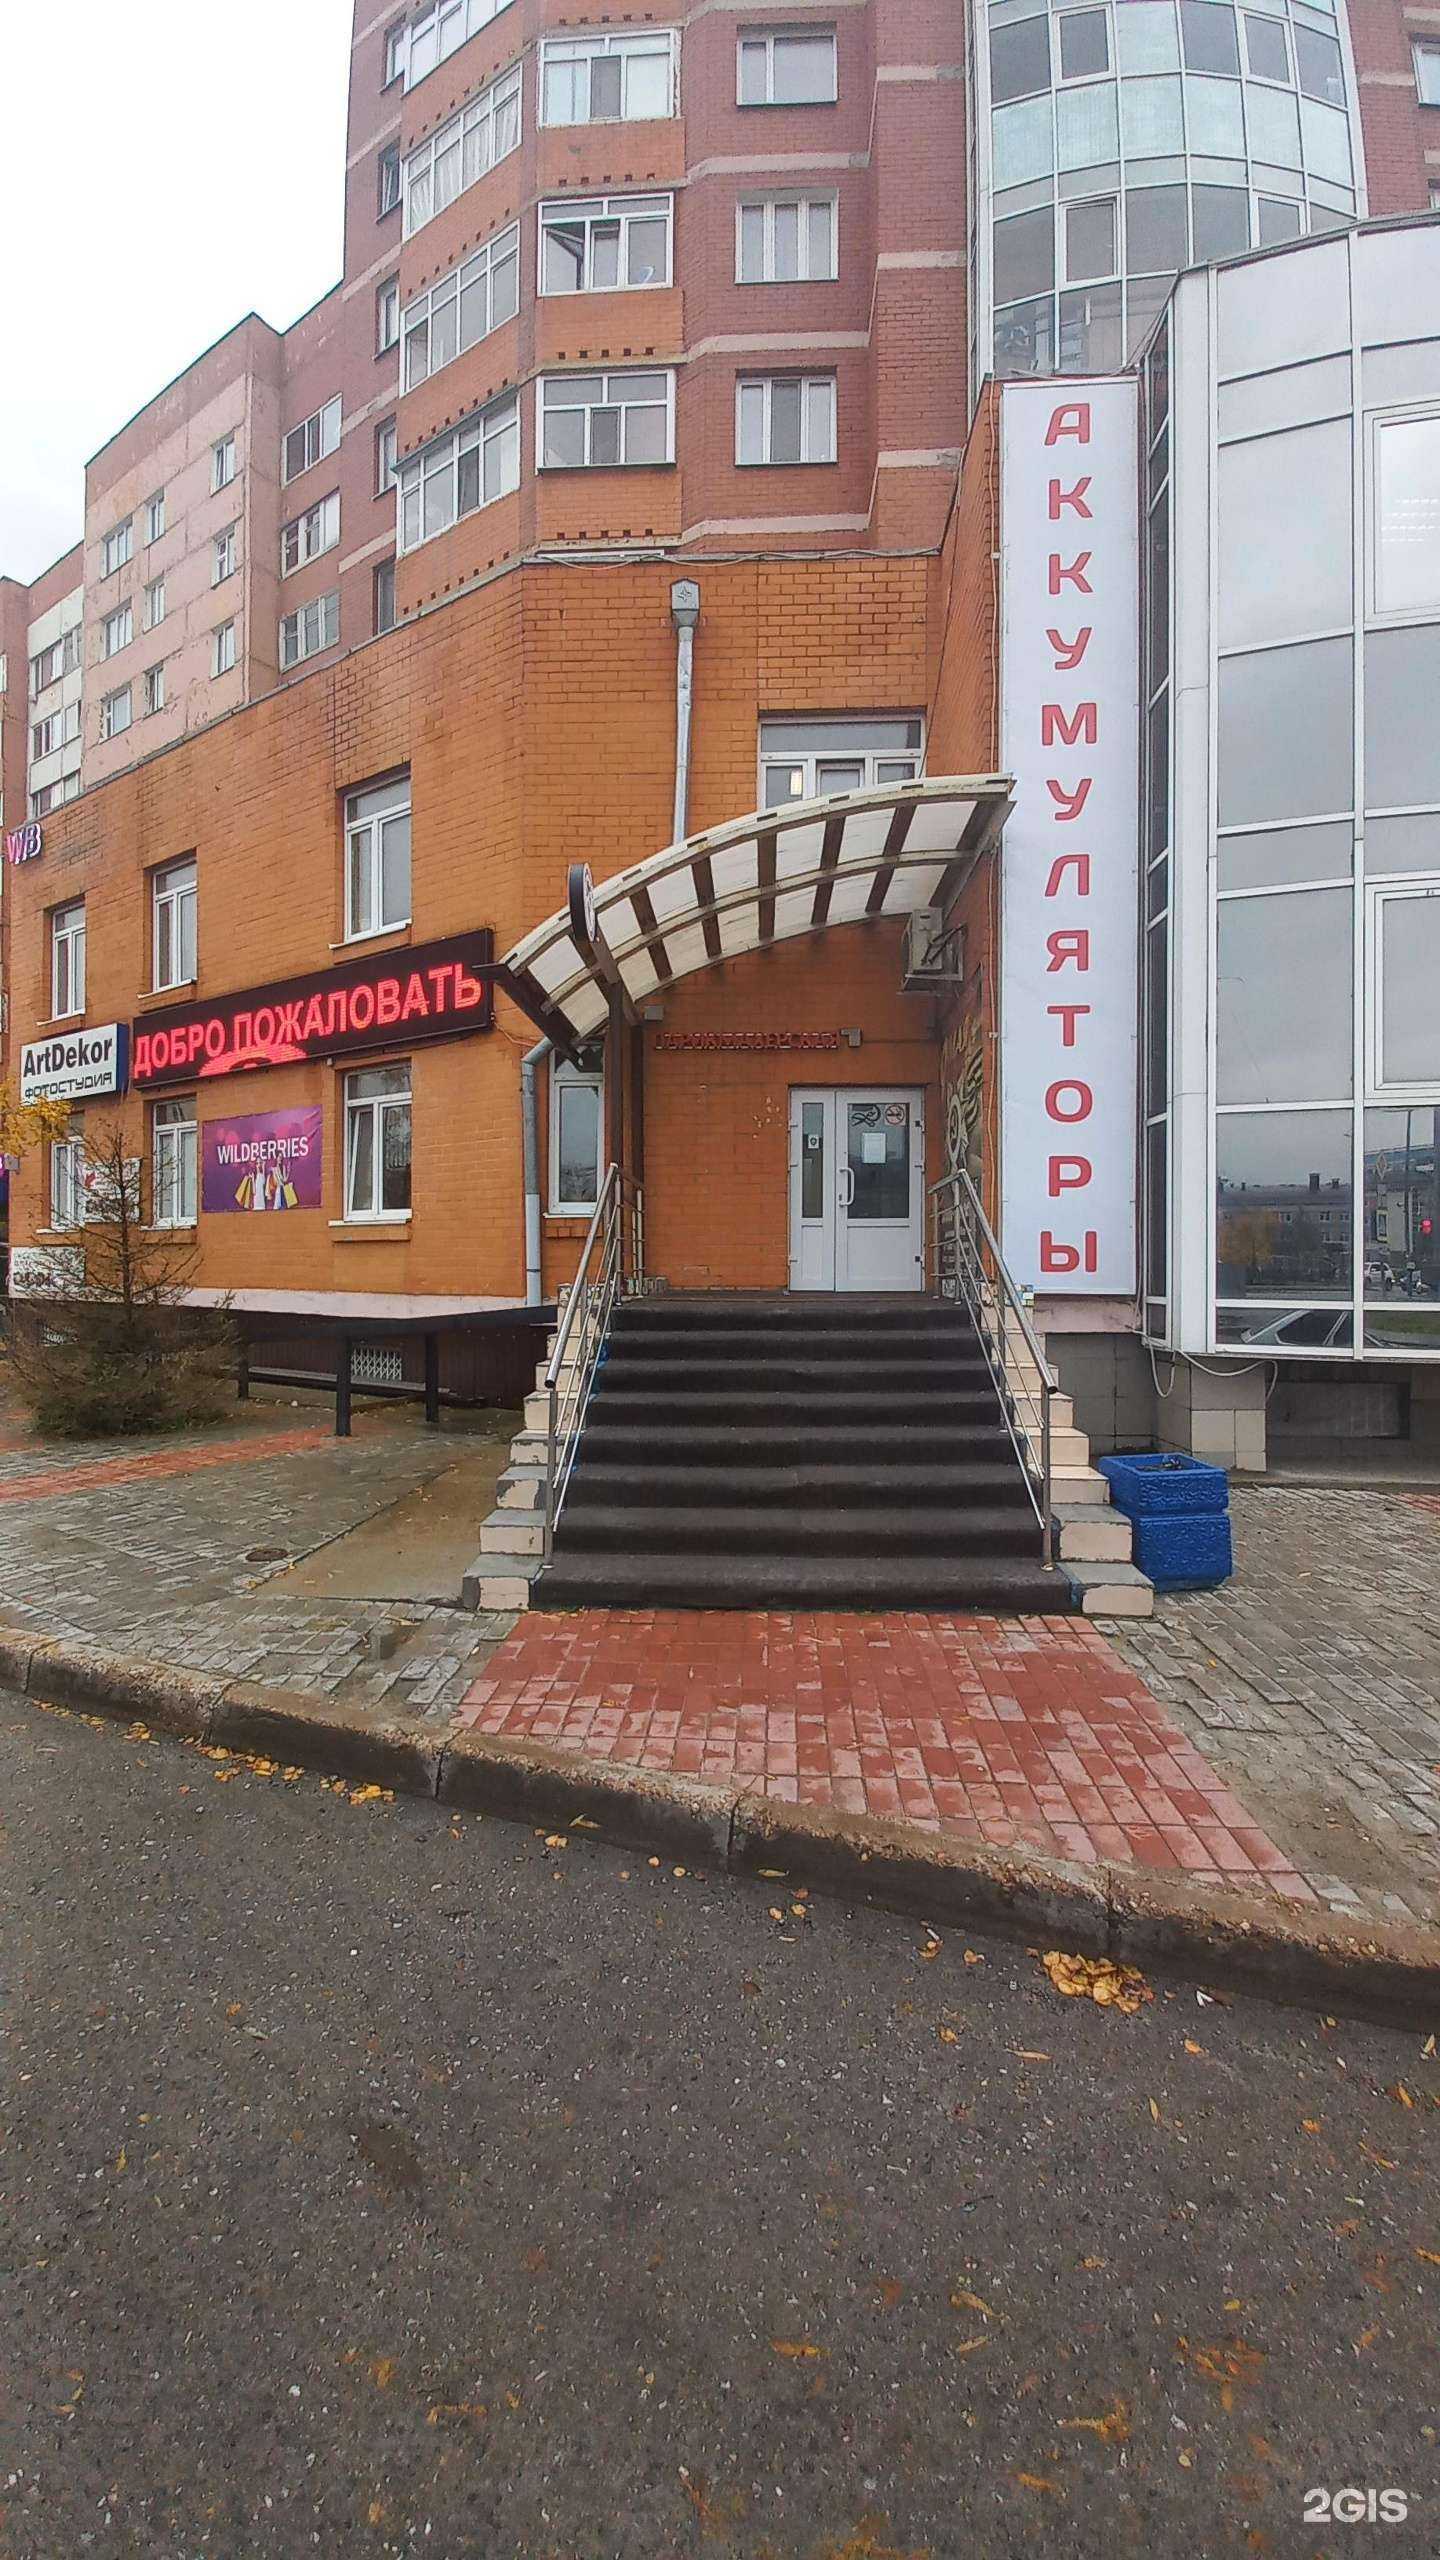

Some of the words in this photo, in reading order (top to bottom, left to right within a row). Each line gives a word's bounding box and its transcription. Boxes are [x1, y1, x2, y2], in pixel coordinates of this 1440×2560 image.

[7, 823, 41, 864] WB
[1040, 402, 1098, 1273] АККУМУЛЯТОРЫ
[134, 1019, 226, 1080] ДОБРО
[233, 963, 482, 1051] ПОЖАЛОВАТЬ
[23, 1038, 113, 1077] ArtDekor
[25, 1071, 113, 1099] ФОТОСТУДИЯ
[217, 1136, 309, 1165] WILDBERRIES
